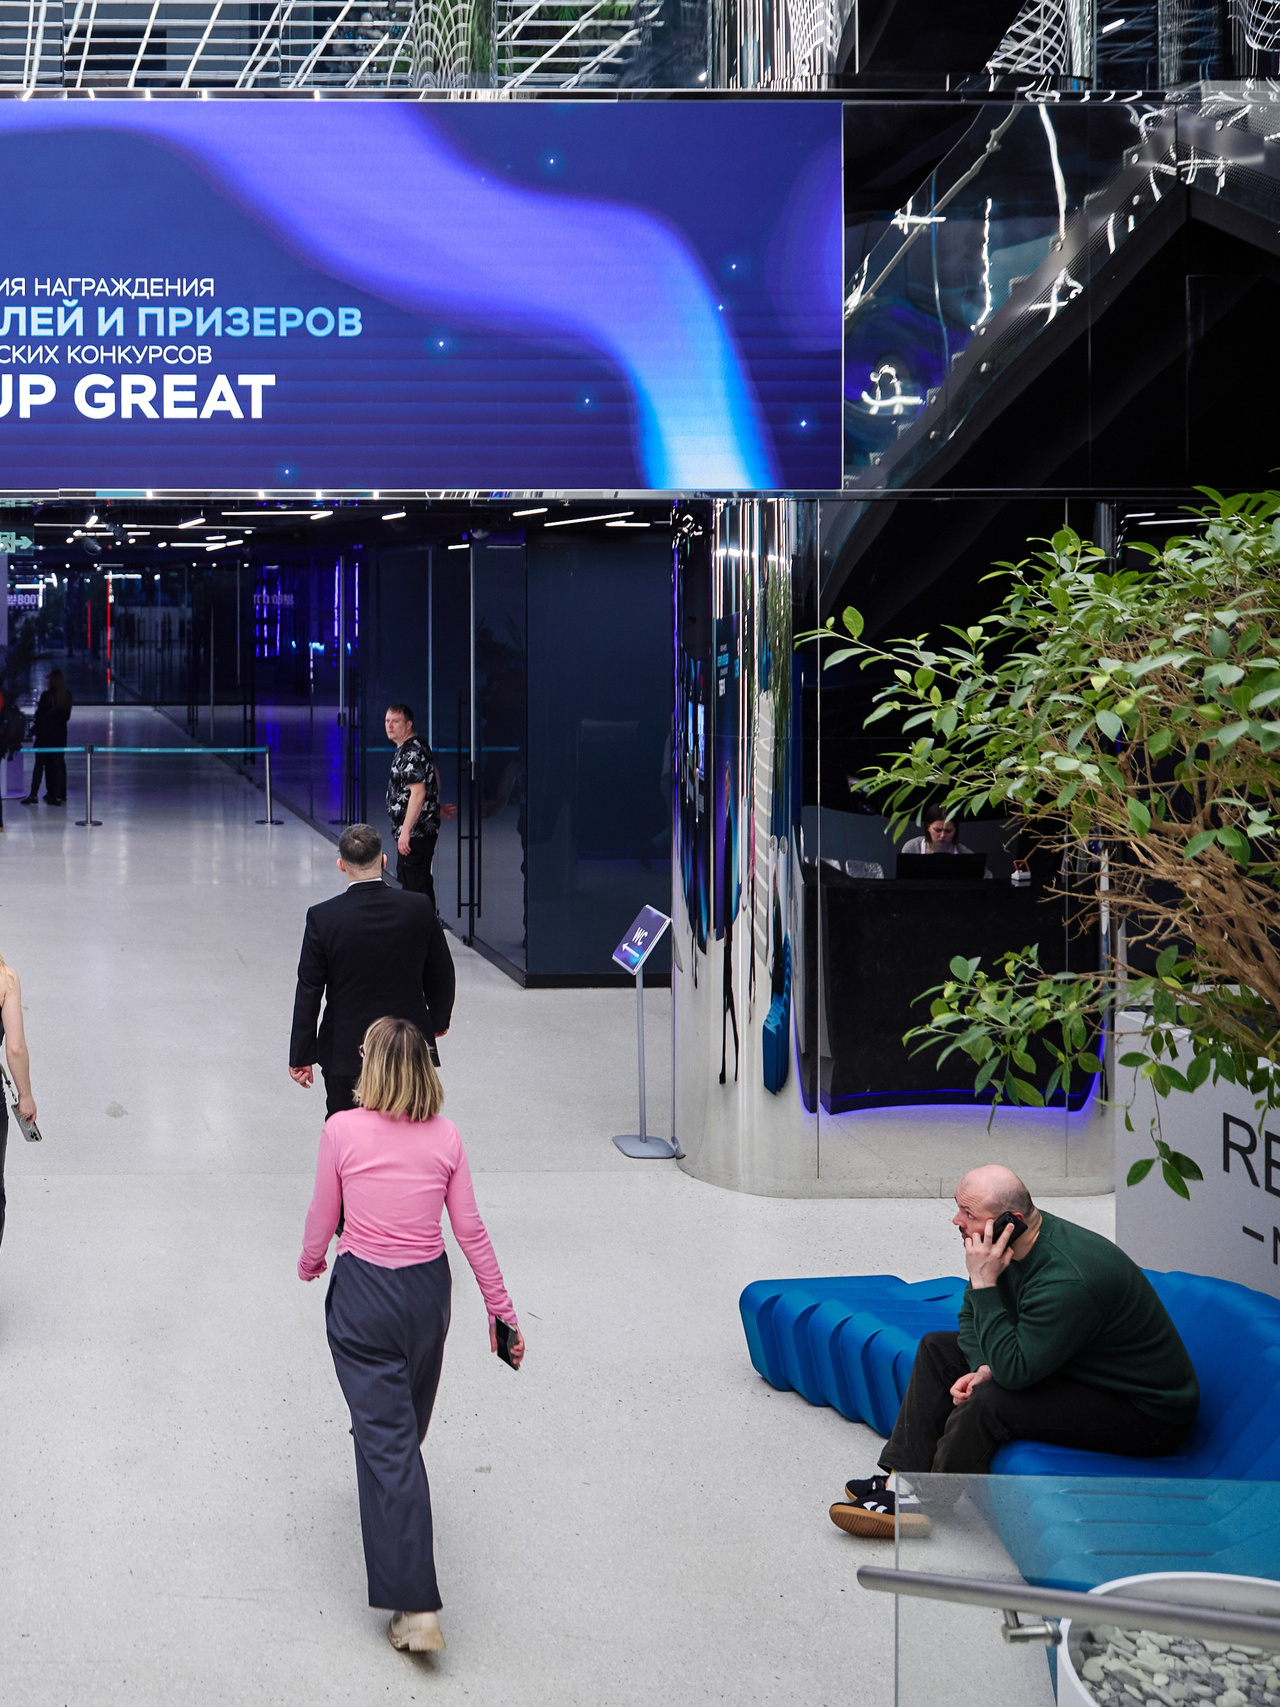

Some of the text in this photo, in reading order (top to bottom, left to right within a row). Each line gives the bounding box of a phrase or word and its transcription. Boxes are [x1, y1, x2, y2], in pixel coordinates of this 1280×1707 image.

[34, 277, 215, 298] НАГРАЖДЕНИЯ
[97, 306, 124, 337] И
[138, 306, 362, 337] ПРИЗЕРОВ
[67, 344, 213, 364] КОНКУРСОВ
[74, 374, 275, 419] GREAT
[631, 926, 649, 946] WC
